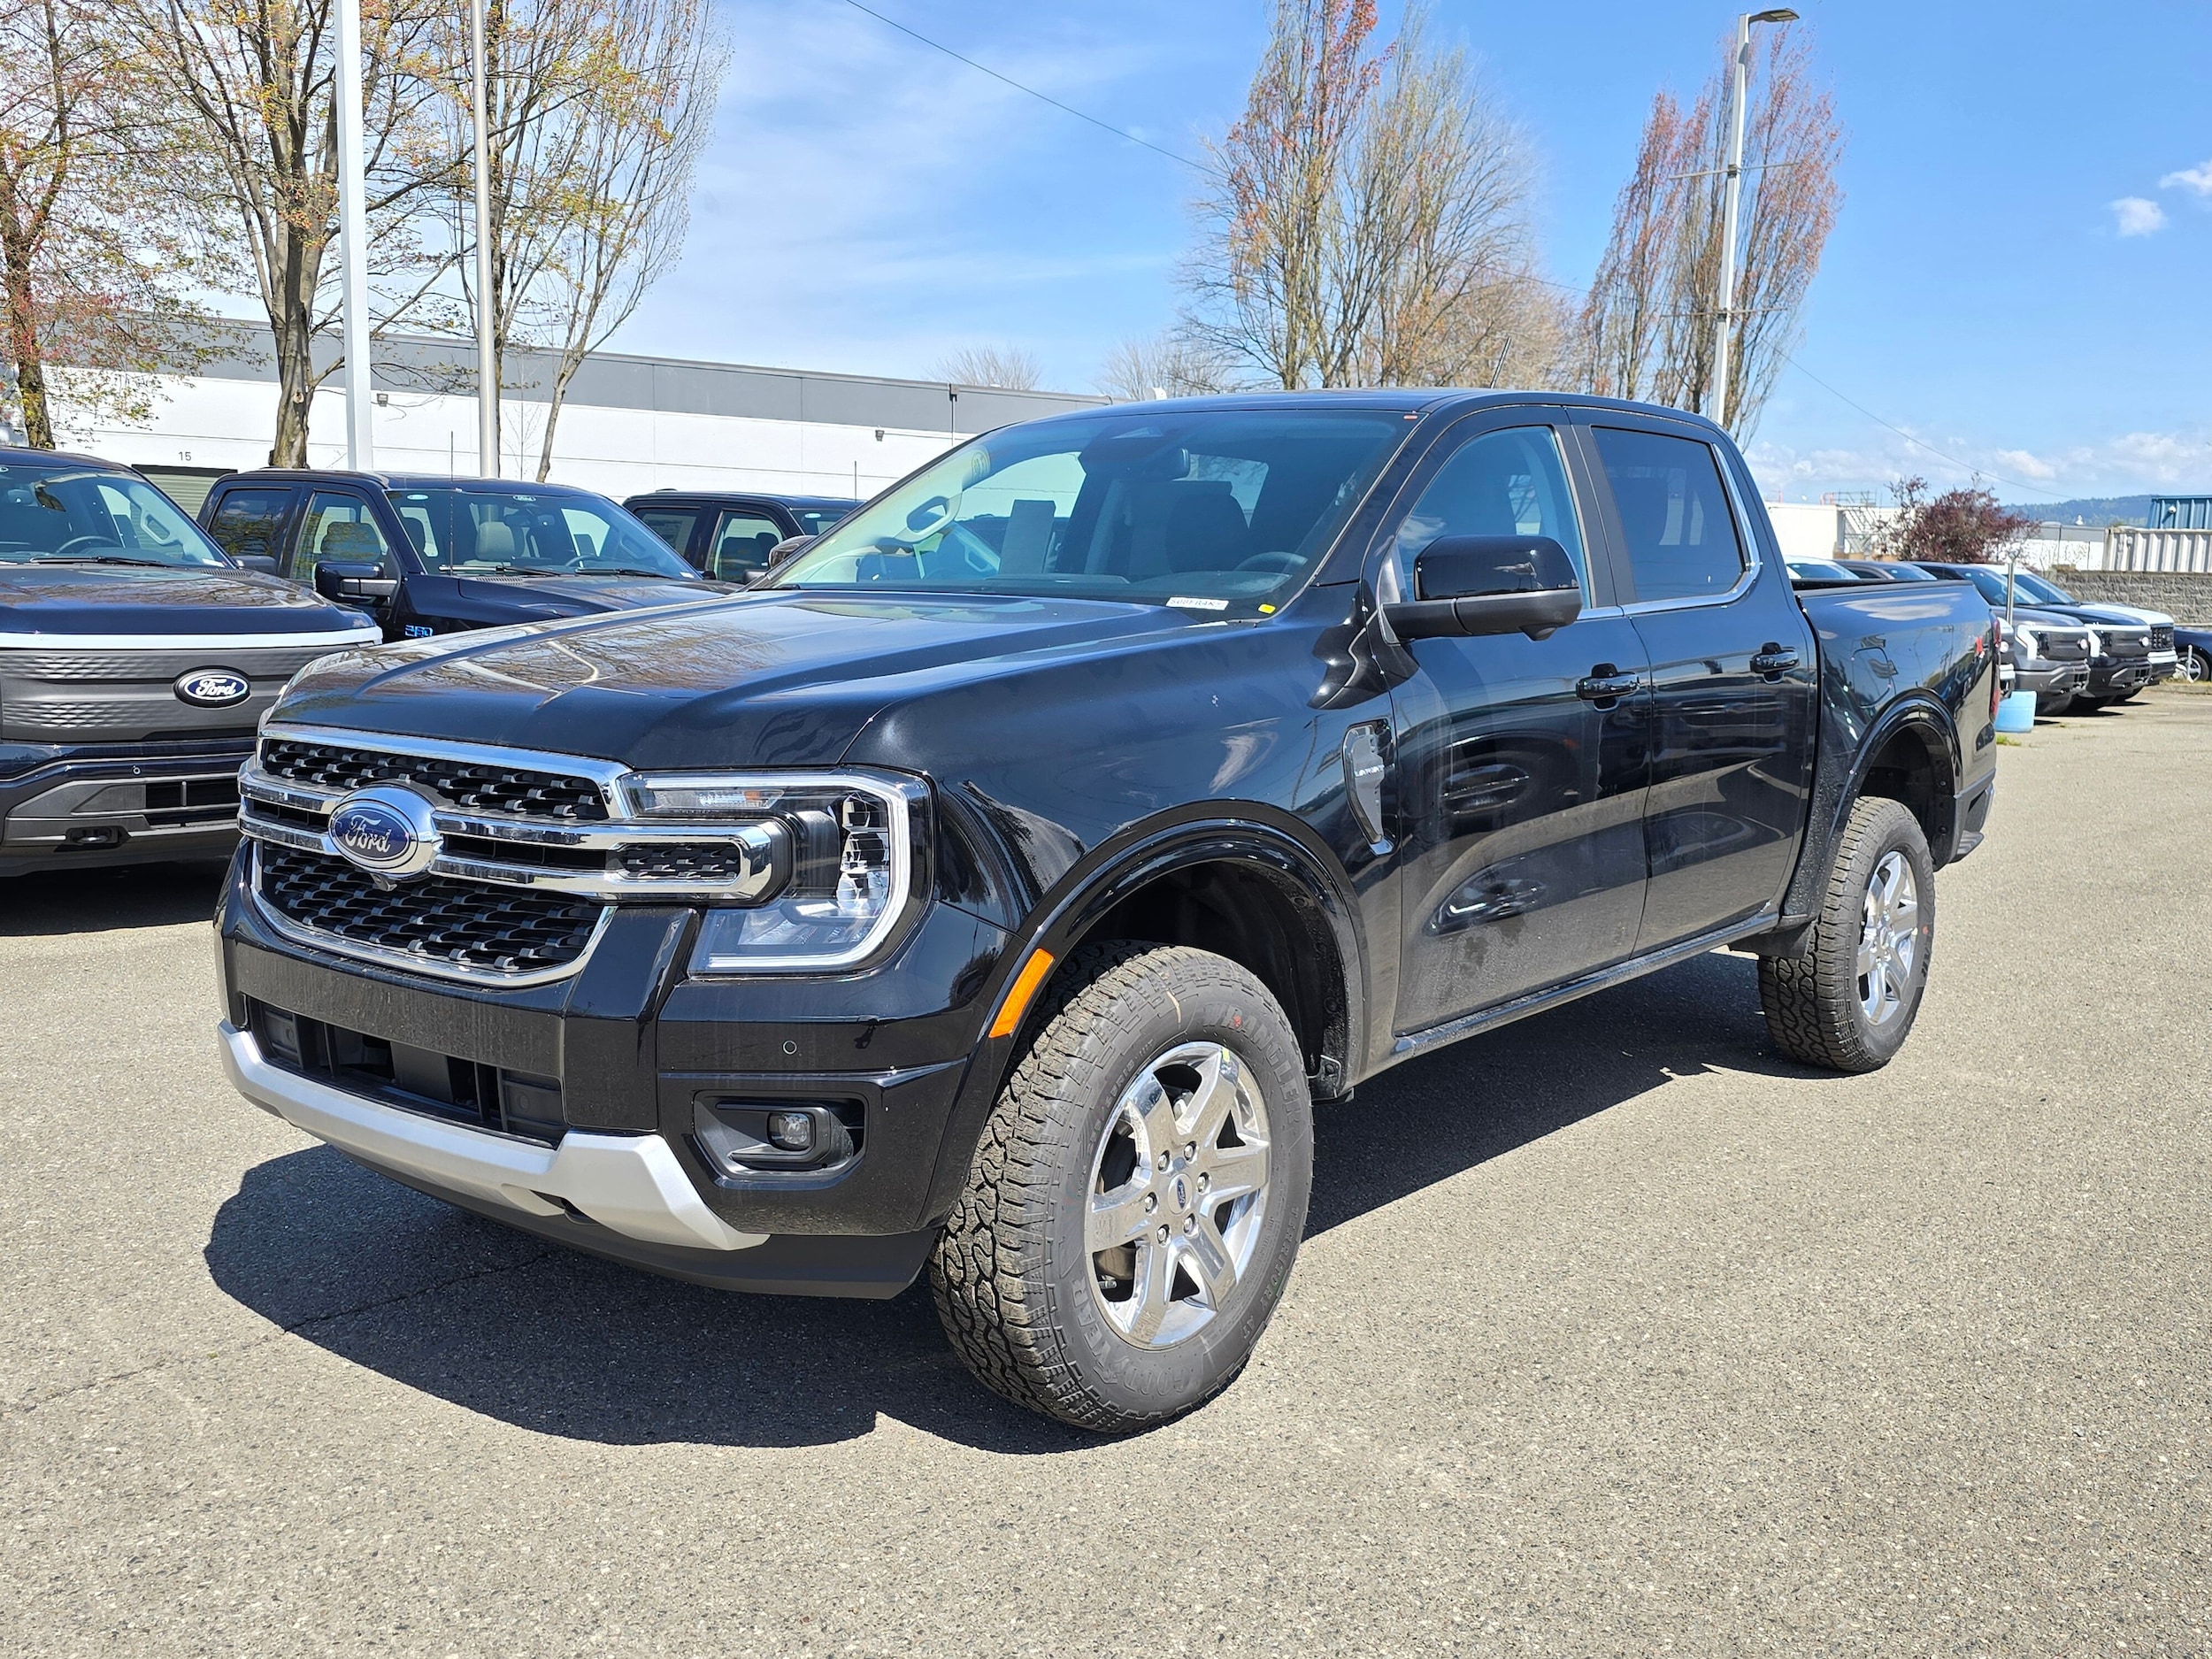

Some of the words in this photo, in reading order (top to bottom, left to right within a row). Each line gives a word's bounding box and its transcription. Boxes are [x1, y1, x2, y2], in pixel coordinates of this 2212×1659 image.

[178, 451, 192, 461] 15
[195, 678, 237, 696] Ford
[345, 814, 392, 853] Ford
[1202, 1002, 1303, 1125] WRANGLER
[1258, 1206, 1301, 1313] TERRITORY
